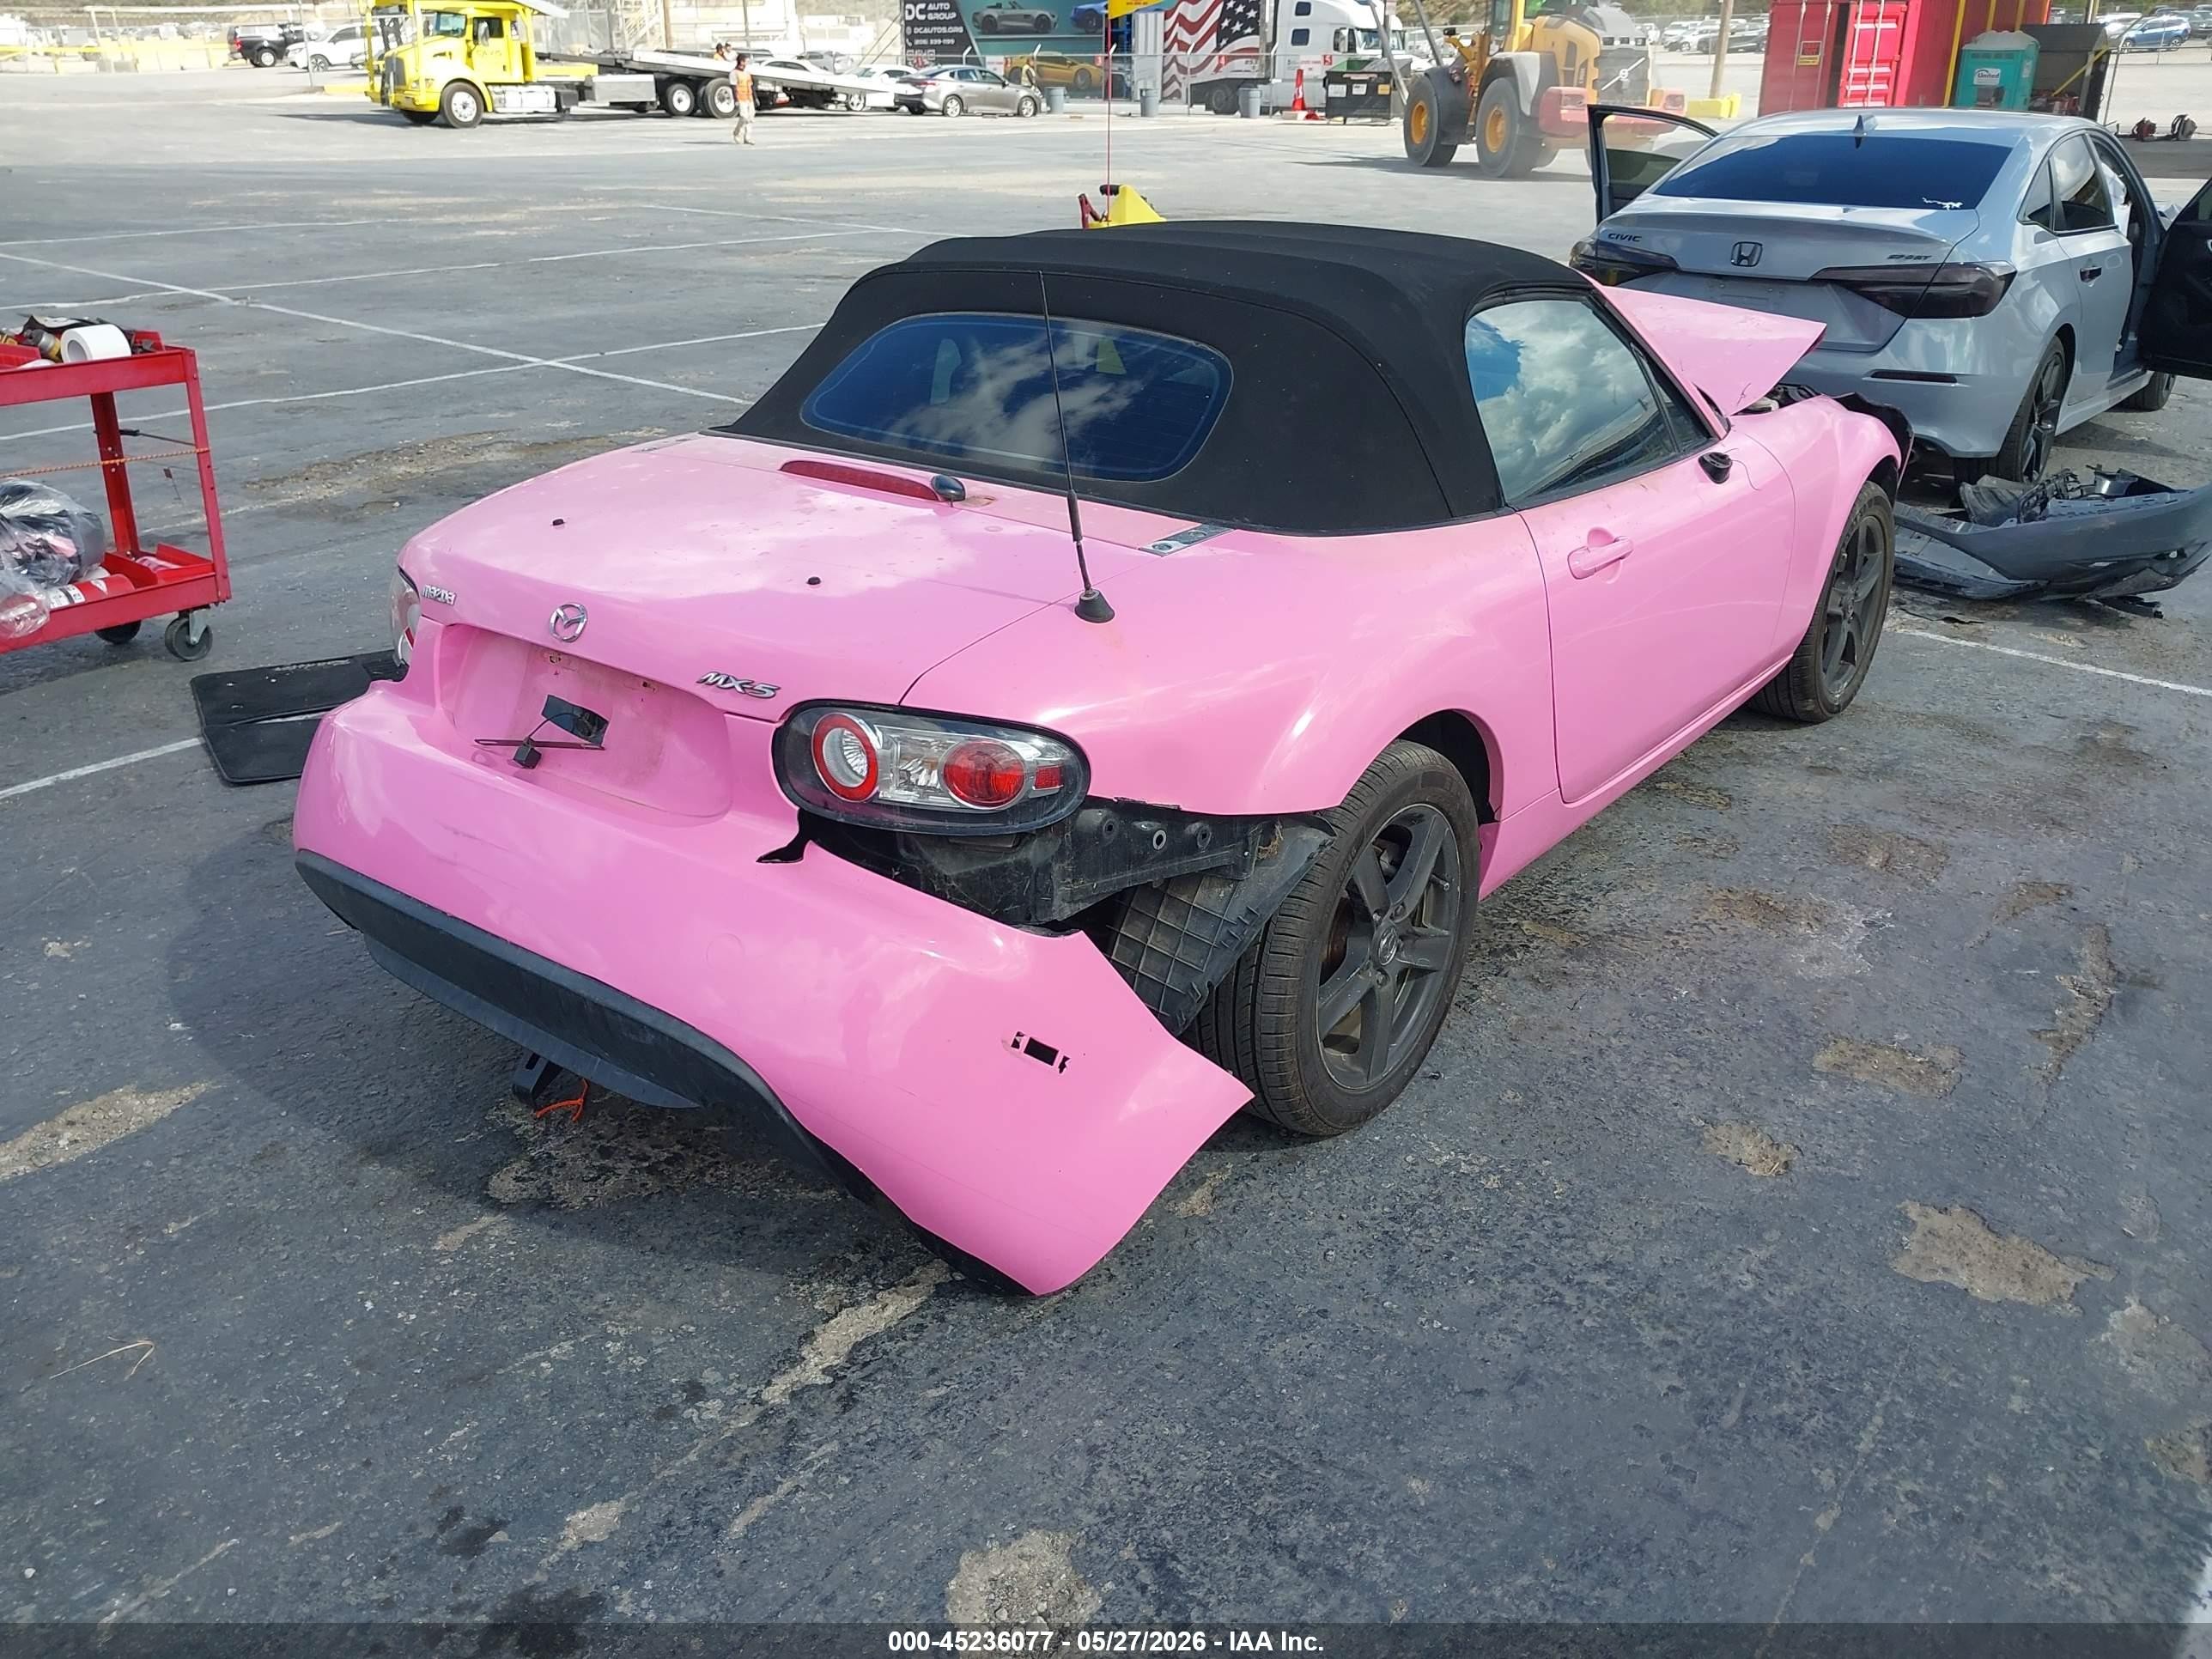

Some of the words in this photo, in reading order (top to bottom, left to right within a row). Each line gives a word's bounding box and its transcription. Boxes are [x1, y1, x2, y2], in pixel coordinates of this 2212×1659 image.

[904, 3, 927, 21] DC
[927, 12, 957, 21] GROUP
[1607, 233, 1643, 242] CIVIC
[696, 672, 781, 699] MX-5
